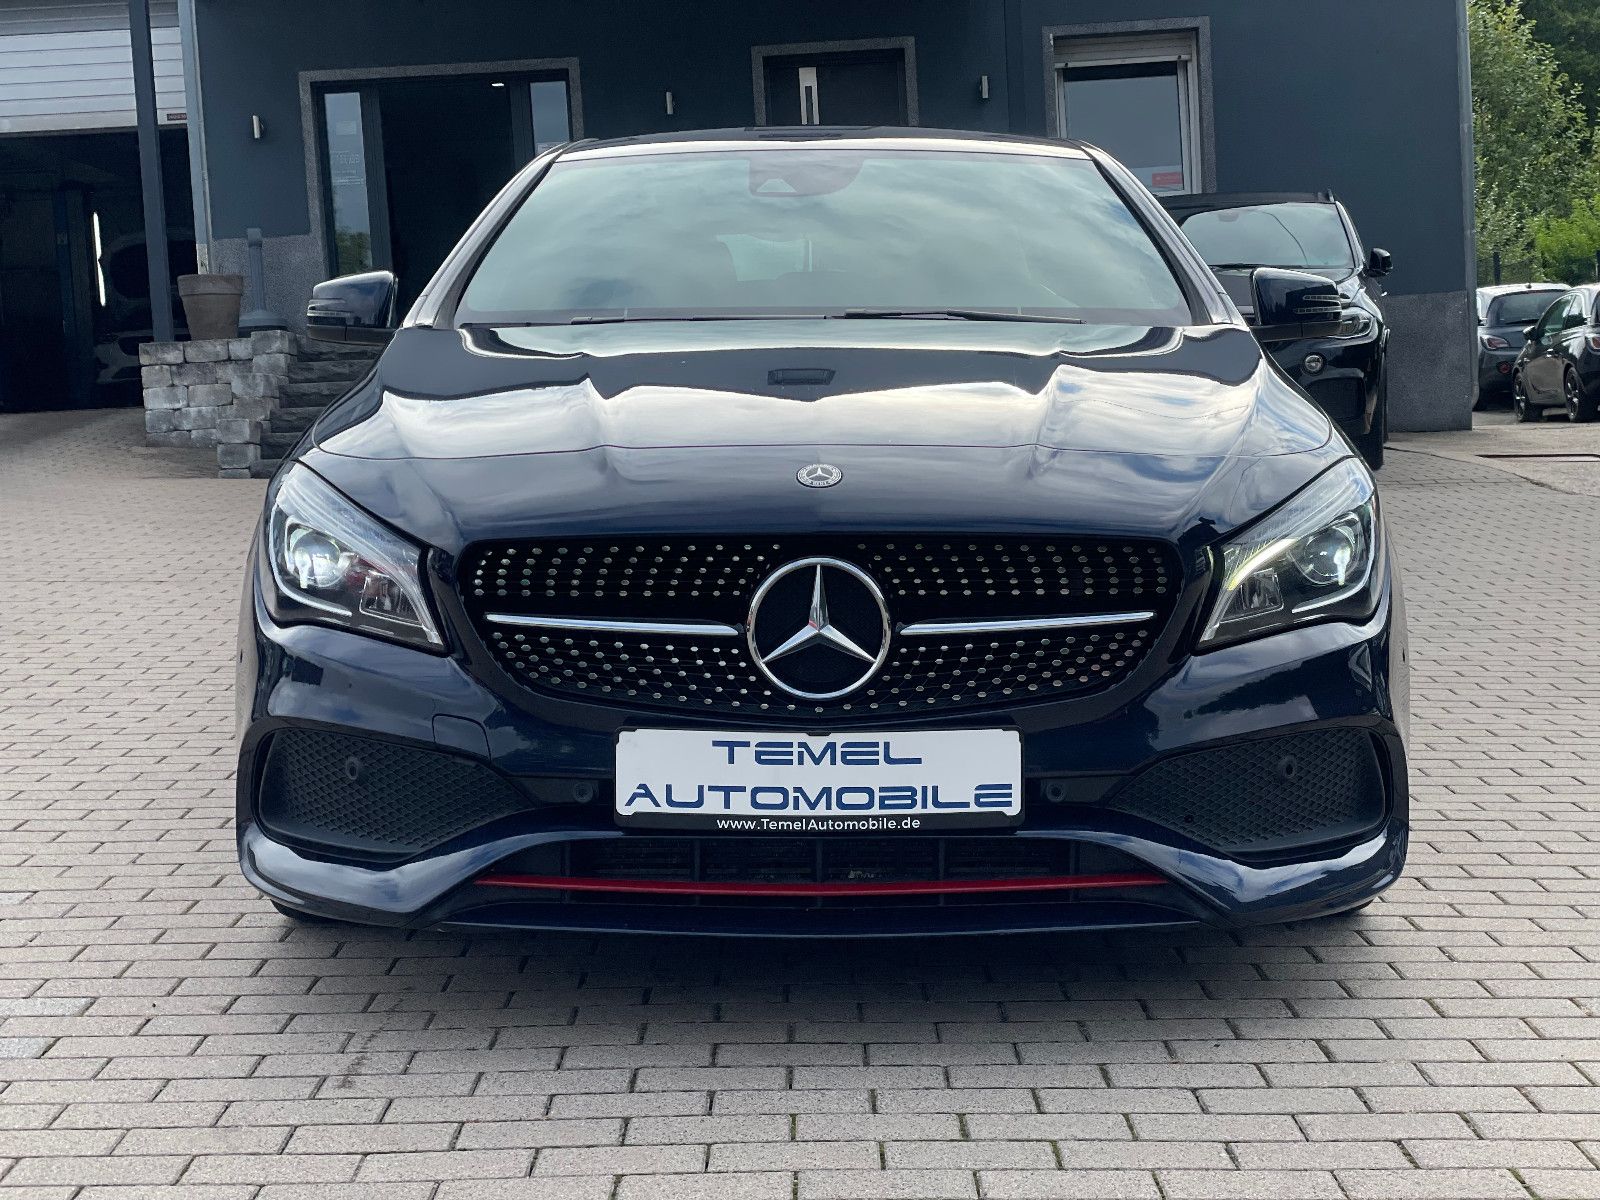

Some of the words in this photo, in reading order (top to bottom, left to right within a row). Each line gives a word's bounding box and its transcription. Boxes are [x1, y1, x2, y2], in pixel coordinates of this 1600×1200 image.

[712, 740, 922, 765] TEMEL
[624, 783, 1012, 810] AUTOMOBILE
[716, 817, 921, 831] www.TemelAutomobile.de
